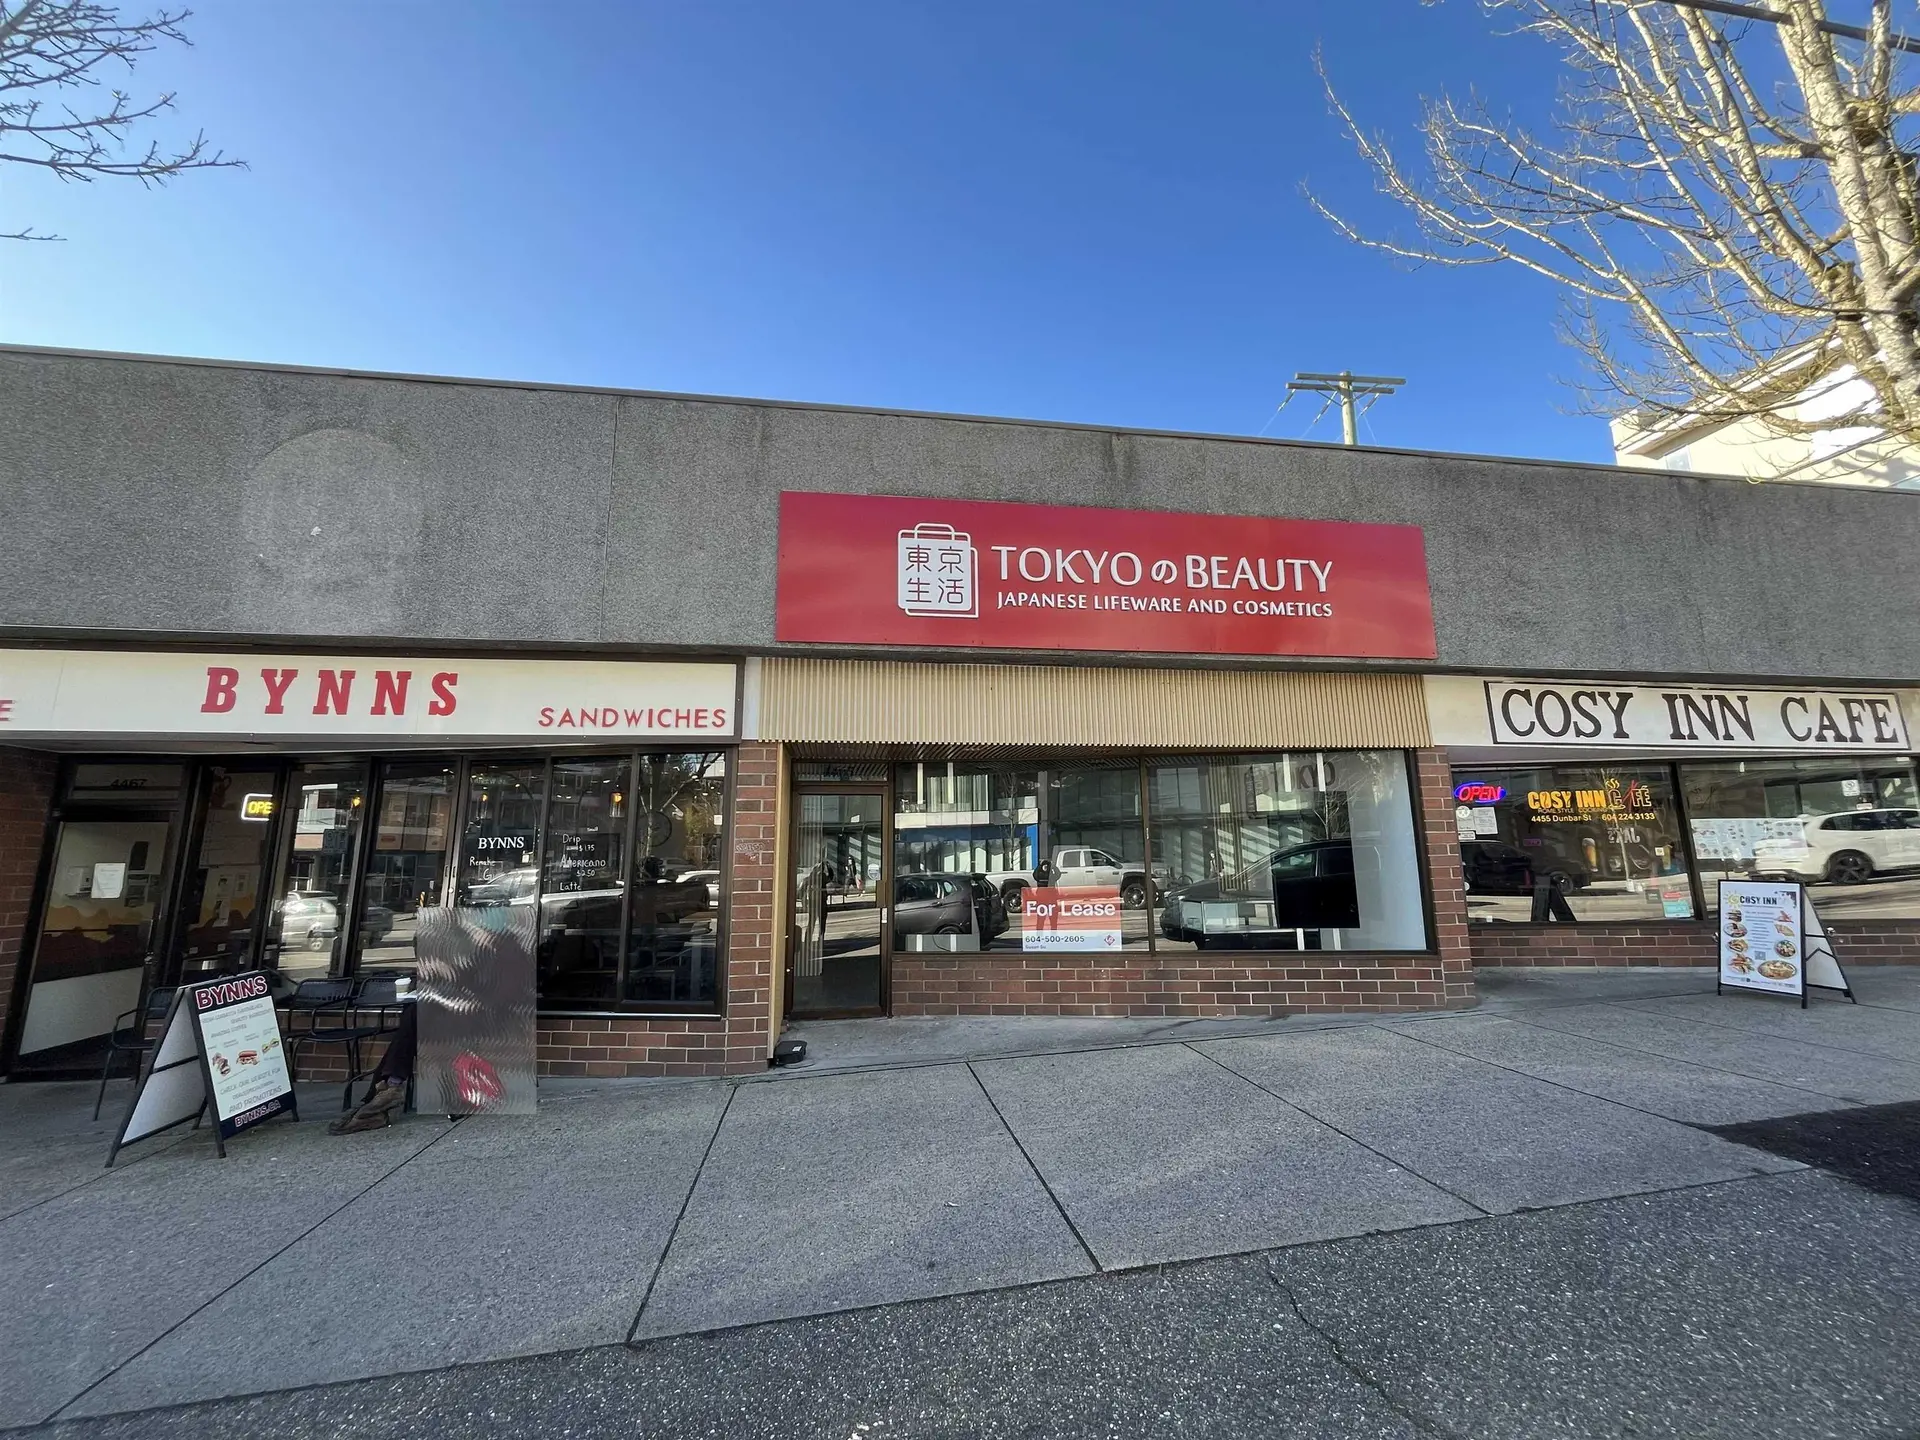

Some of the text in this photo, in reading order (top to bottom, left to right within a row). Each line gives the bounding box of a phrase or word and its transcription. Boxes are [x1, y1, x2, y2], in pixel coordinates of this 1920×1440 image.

[905, 544, 965, 575] 東京
[991, 545, 1333, 593] TOKYO の BEAUTY
[904, 577, 965, 605] 生活
[996, 592, 1333, 618] JAPANESE LIFEWARE AND COSMETICS
[200, 667, 459, 716] BYNNS
[538, 706, 727, 729] SANDWICHES
[1501, 688, 1899, 743] COSY INN CAFE
[1458, 785, 1503, 801] OPEN
[1527, 791, 1572, 810] COSY
[1575, 790, 1607, 808] INN
[247, 801, 273, 815] OPE
[1531, 814, 1551, 822] 4455
[1552, 814, 1581, 822] Dunbar
[1583, 813, 1592, 821] St
[1634, 812, 1655, 820] 3133
[477, 836, 525, 849] BYNNS
[562, 833, 581, 846] Drip
[560, 881, 582, 891] Latte
[1026, 900, 1116, 917] For Lease
[1739, 895, 1778, 905] COSY INN
[1025, 935, 1085, 943] 604-500-2605
[196, 975, 268, 1010] BYNNS
